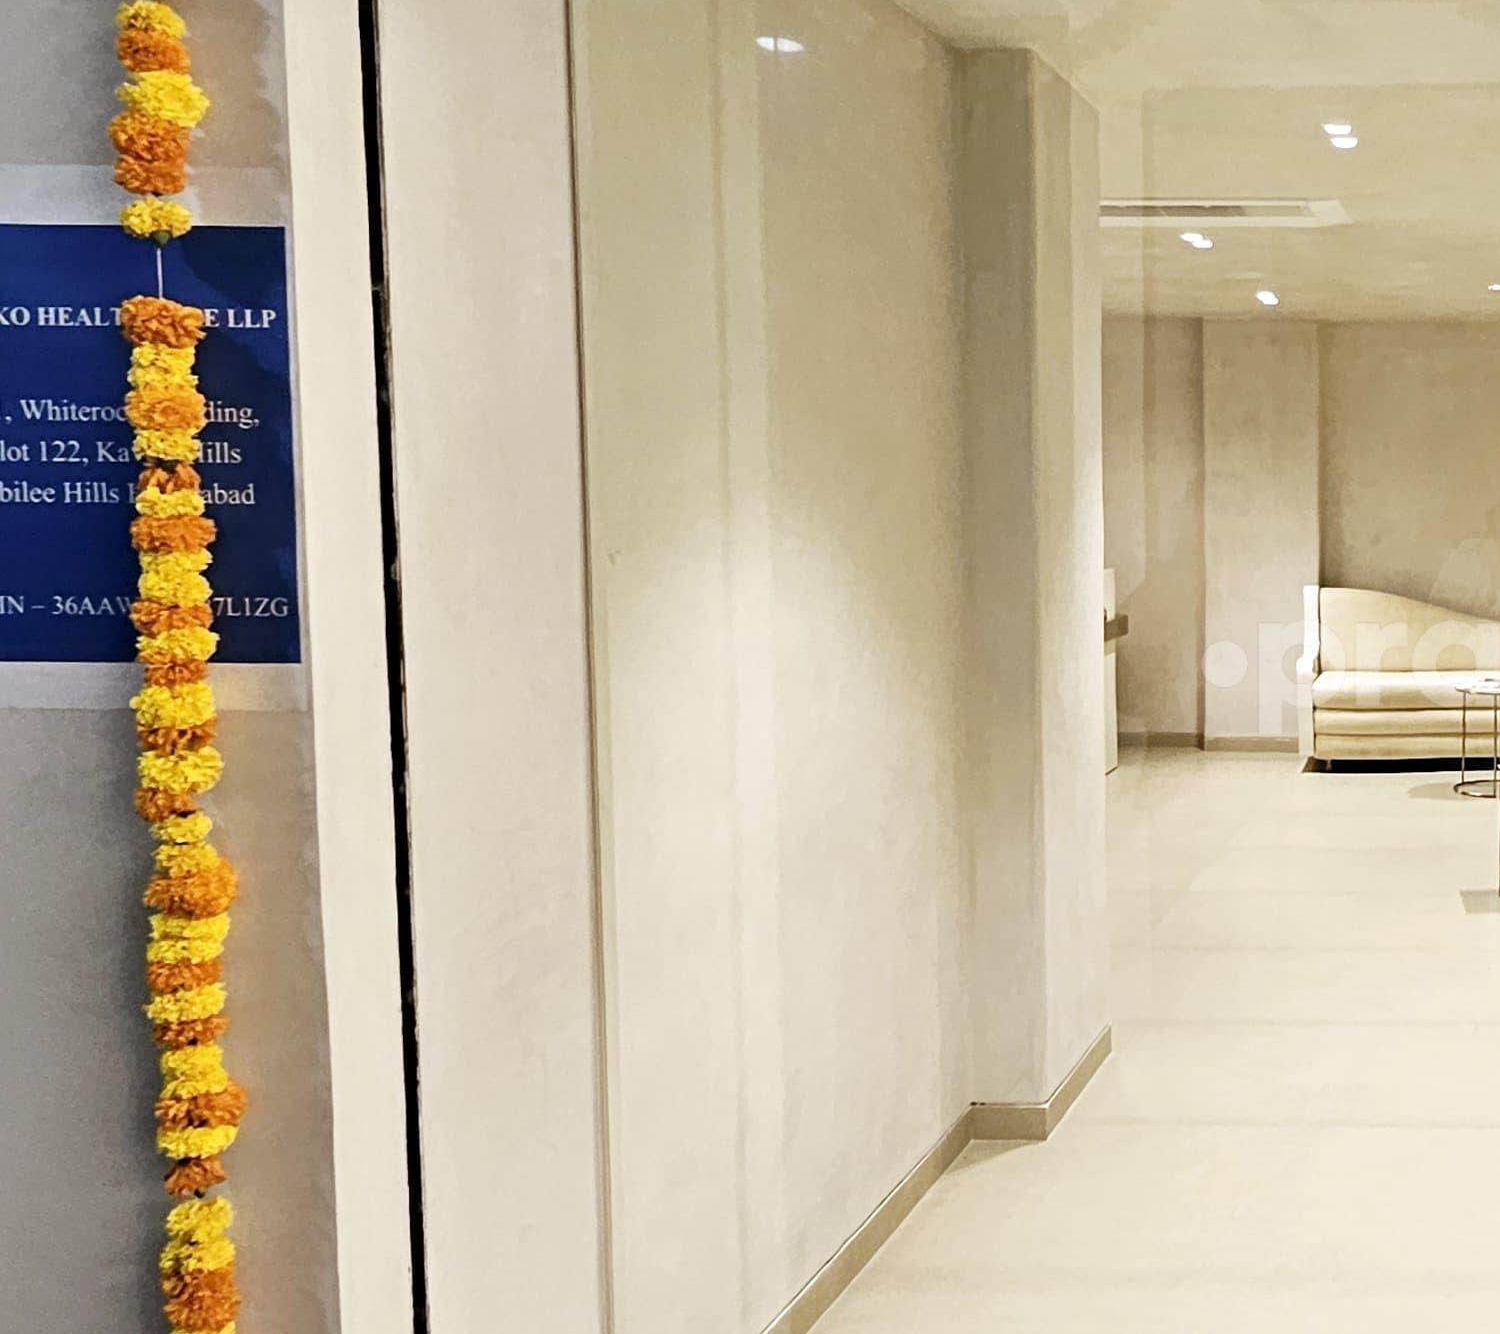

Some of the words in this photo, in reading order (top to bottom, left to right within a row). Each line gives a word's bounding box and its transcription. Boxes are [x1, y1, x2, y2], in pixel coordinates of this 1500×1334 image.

[228, 310, 277, 328] LLP
[39, 441, 89, 466] 122,
[64, 482, 120, 504] Hills
